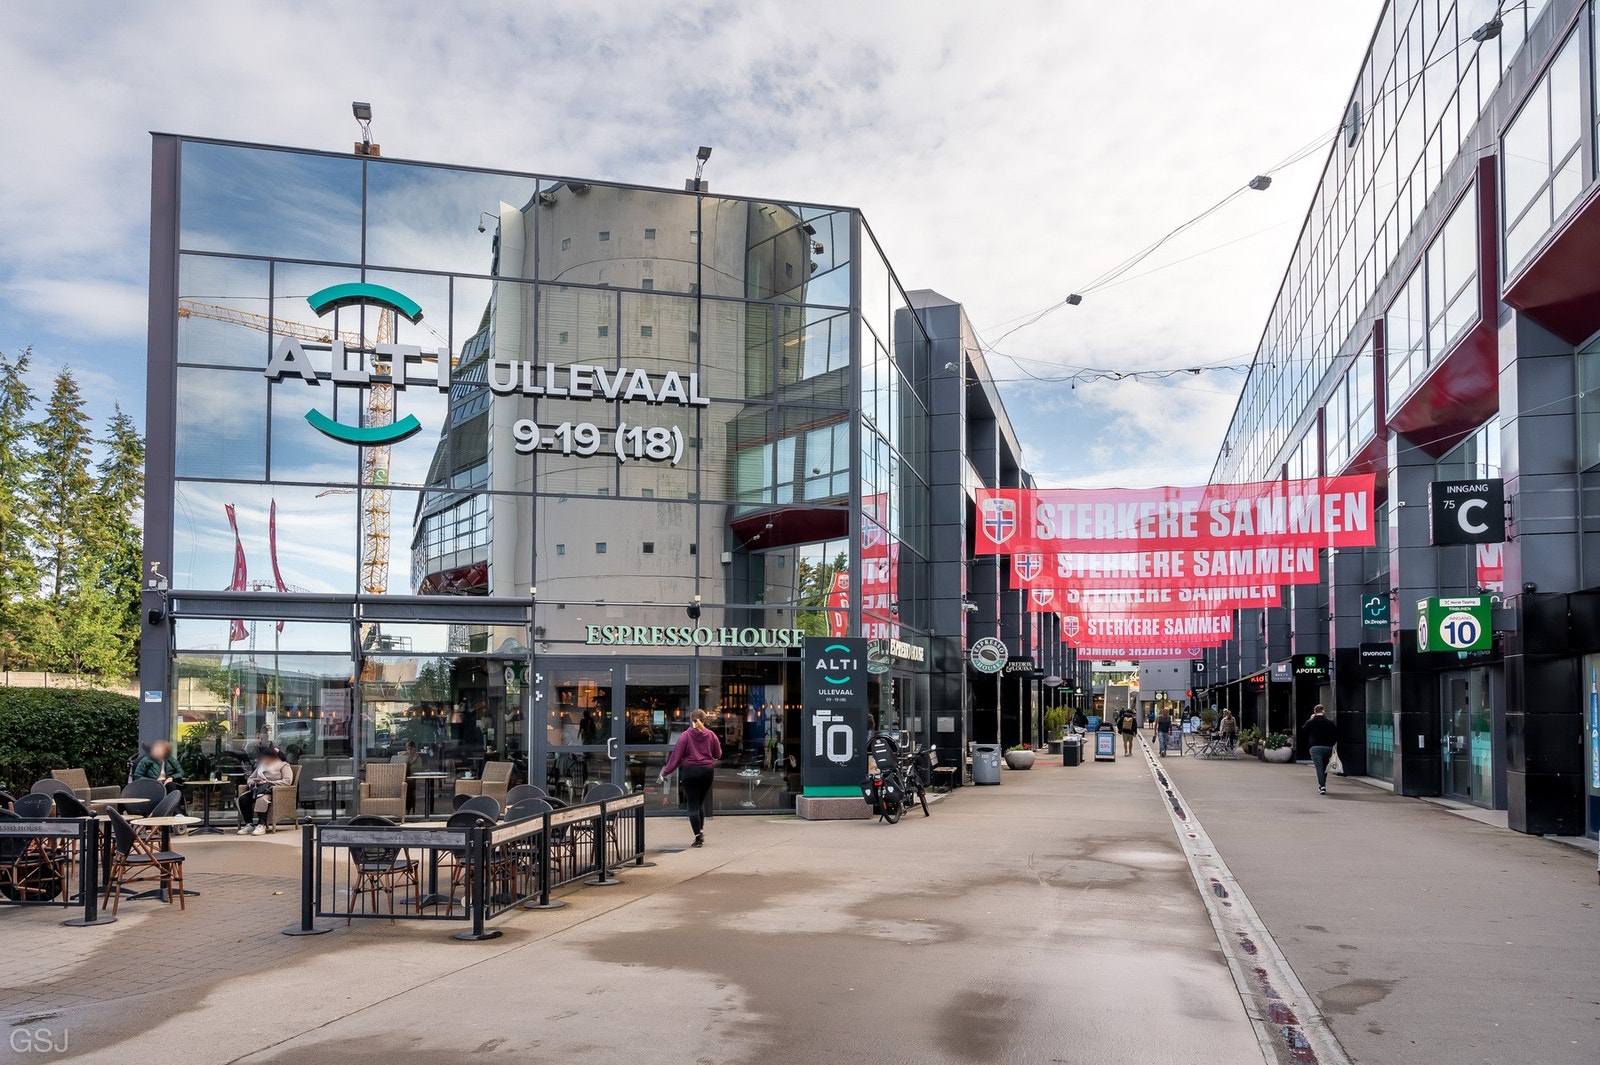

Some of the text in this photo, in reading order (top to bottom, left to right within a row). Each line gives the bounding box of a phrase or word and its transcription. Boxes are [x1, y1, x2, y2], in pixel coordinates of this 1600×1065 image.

[265, 336, 450, 390] ALTI
[488, 358, 710, 406] ULLEVAAL
[513, 419, 684, 465] 9-19 (18)
[1446, 484, 1489, 494] INNGANG
[1036, 491, 1367, 540] STERKERE SAMMEN
[1443, 498, 1489, 534] 75 C
[1057, 547, 1314, 579] STERKERE SAMMEN
[585, 624, 805, 647] ESPRESSO HOUSE
[1088, 615, 1230, 637] STERKERE SAMMEN
[1444, 621, 1476, 645] 10
[815, 659, 857, 670] ALTI
[974, 639, 1005, 670] ESPRESSO HOUSE
[1197, 663, 1204, 671] D
